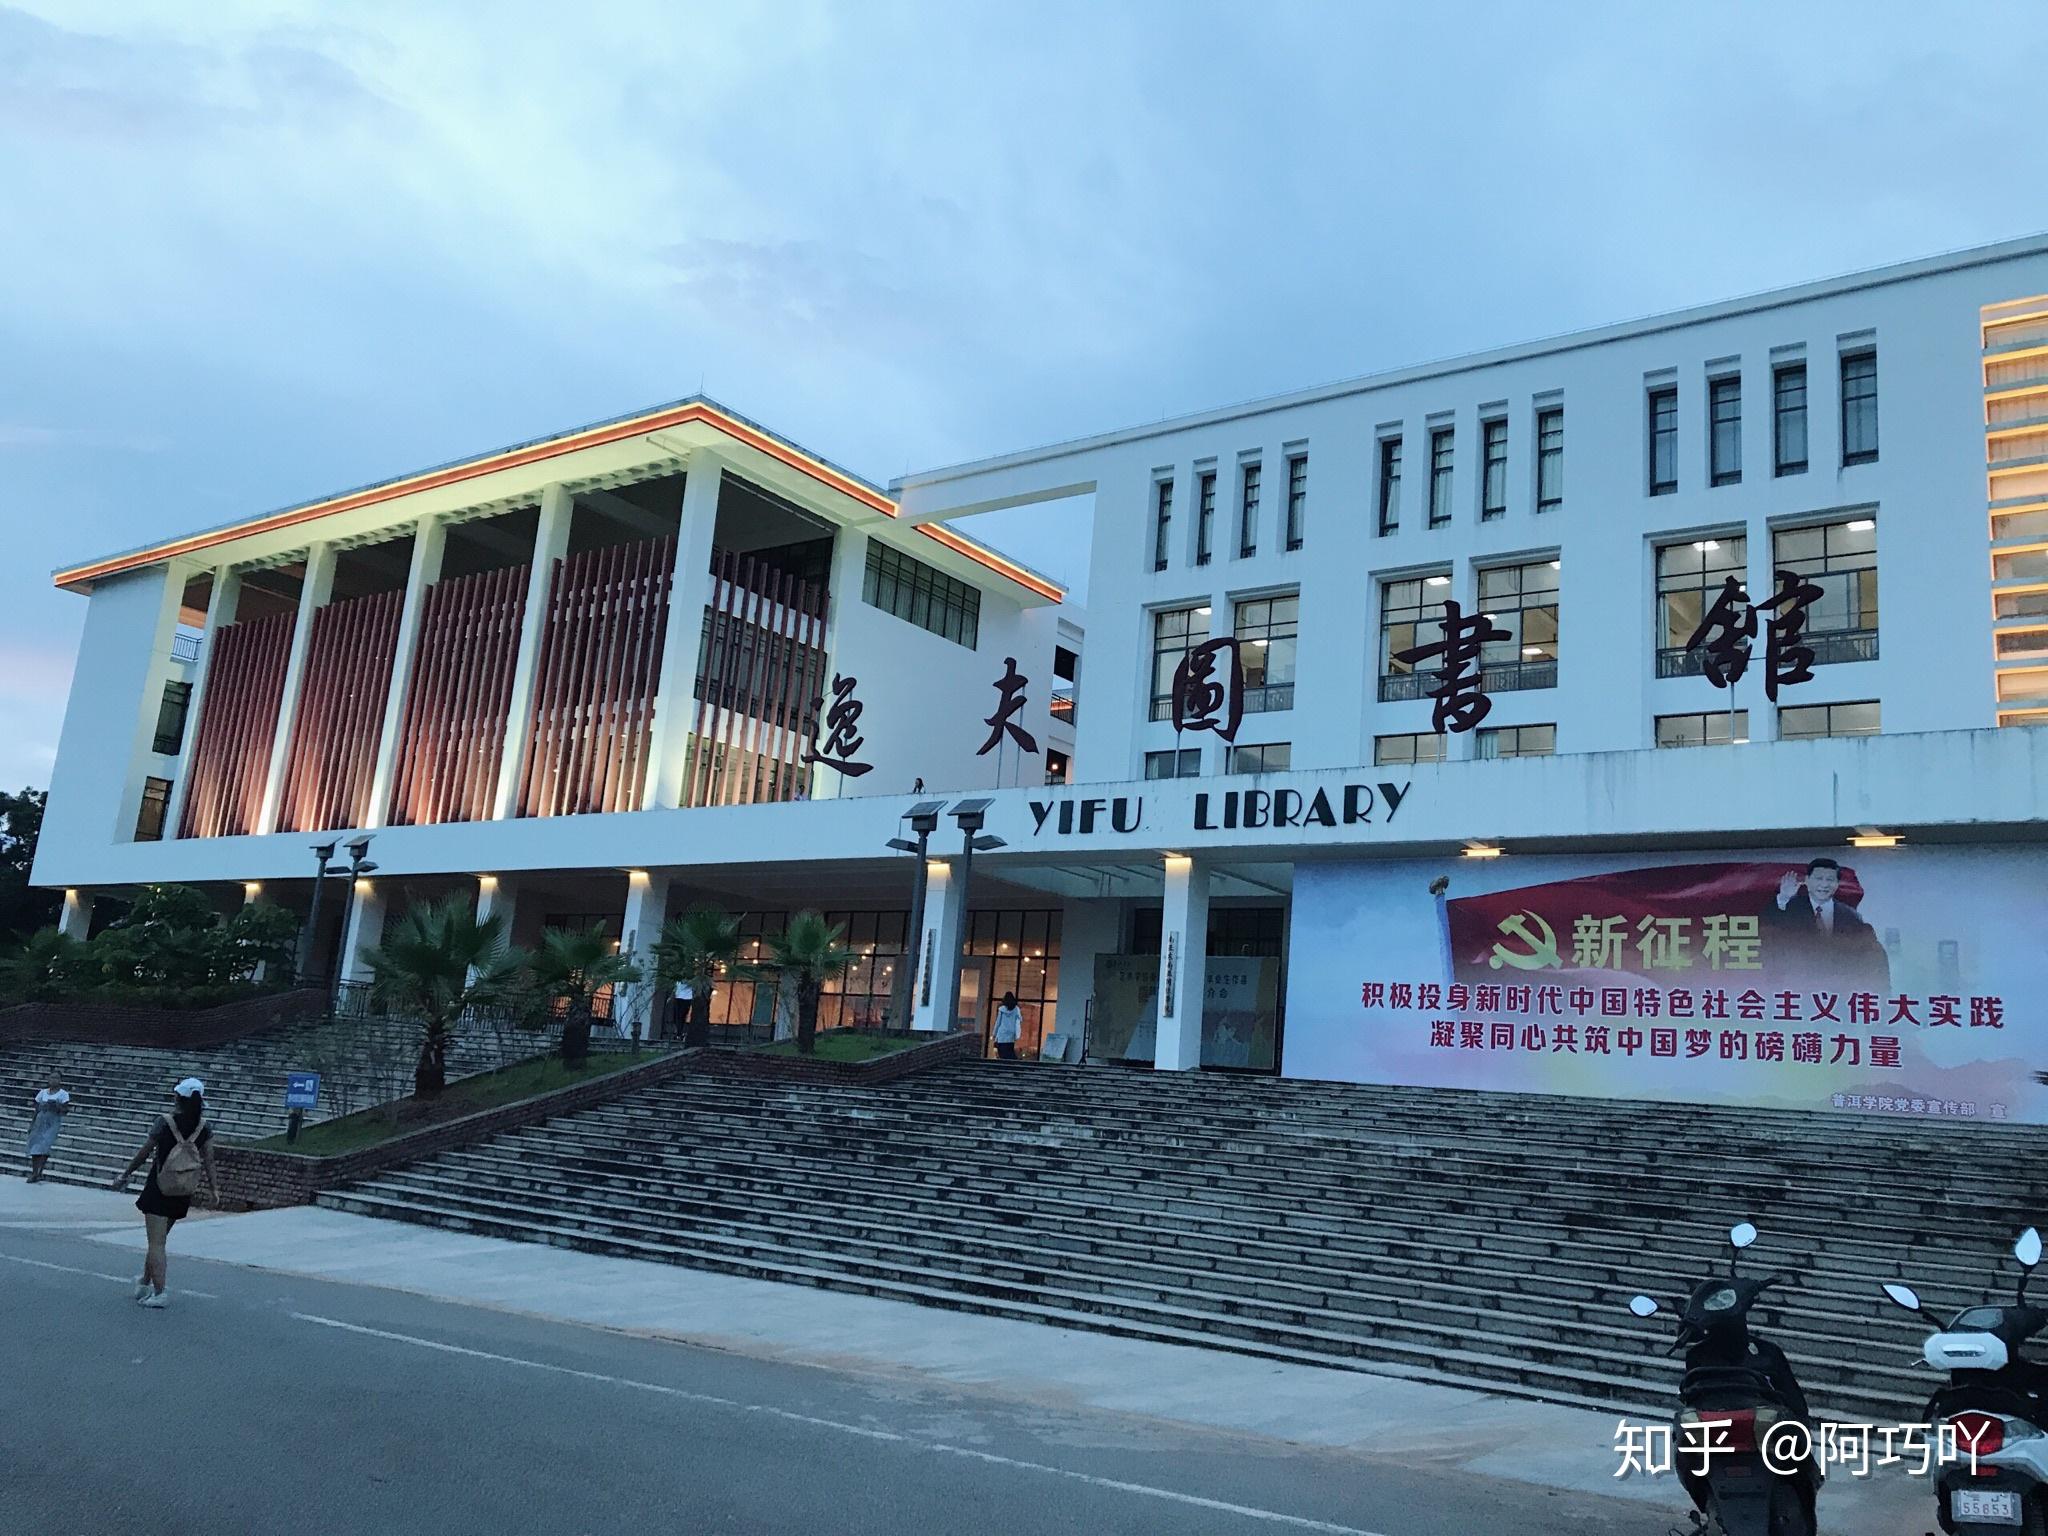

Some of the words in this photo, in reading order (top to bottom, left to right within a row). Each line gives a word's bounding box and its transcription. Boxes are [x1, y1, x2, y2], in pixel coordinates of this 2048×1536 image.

[1029, 796, 1143, 836] YIFU
[1194, 781, 1411, 830] LIBRARY
[1571, 913, 1763, 971] 新征程
[1361, 981, 2005, 1029] 积极投身新时代中国特色社会主义伟大实践
[1430, 1020, 1903, 1068] 凝聚同心共筑中国梦的磅礴力量
[1831, 1093, 1977, 1118] 普洱学院党委宣传部
[1963, 1502, 2010, 1516] 55853
